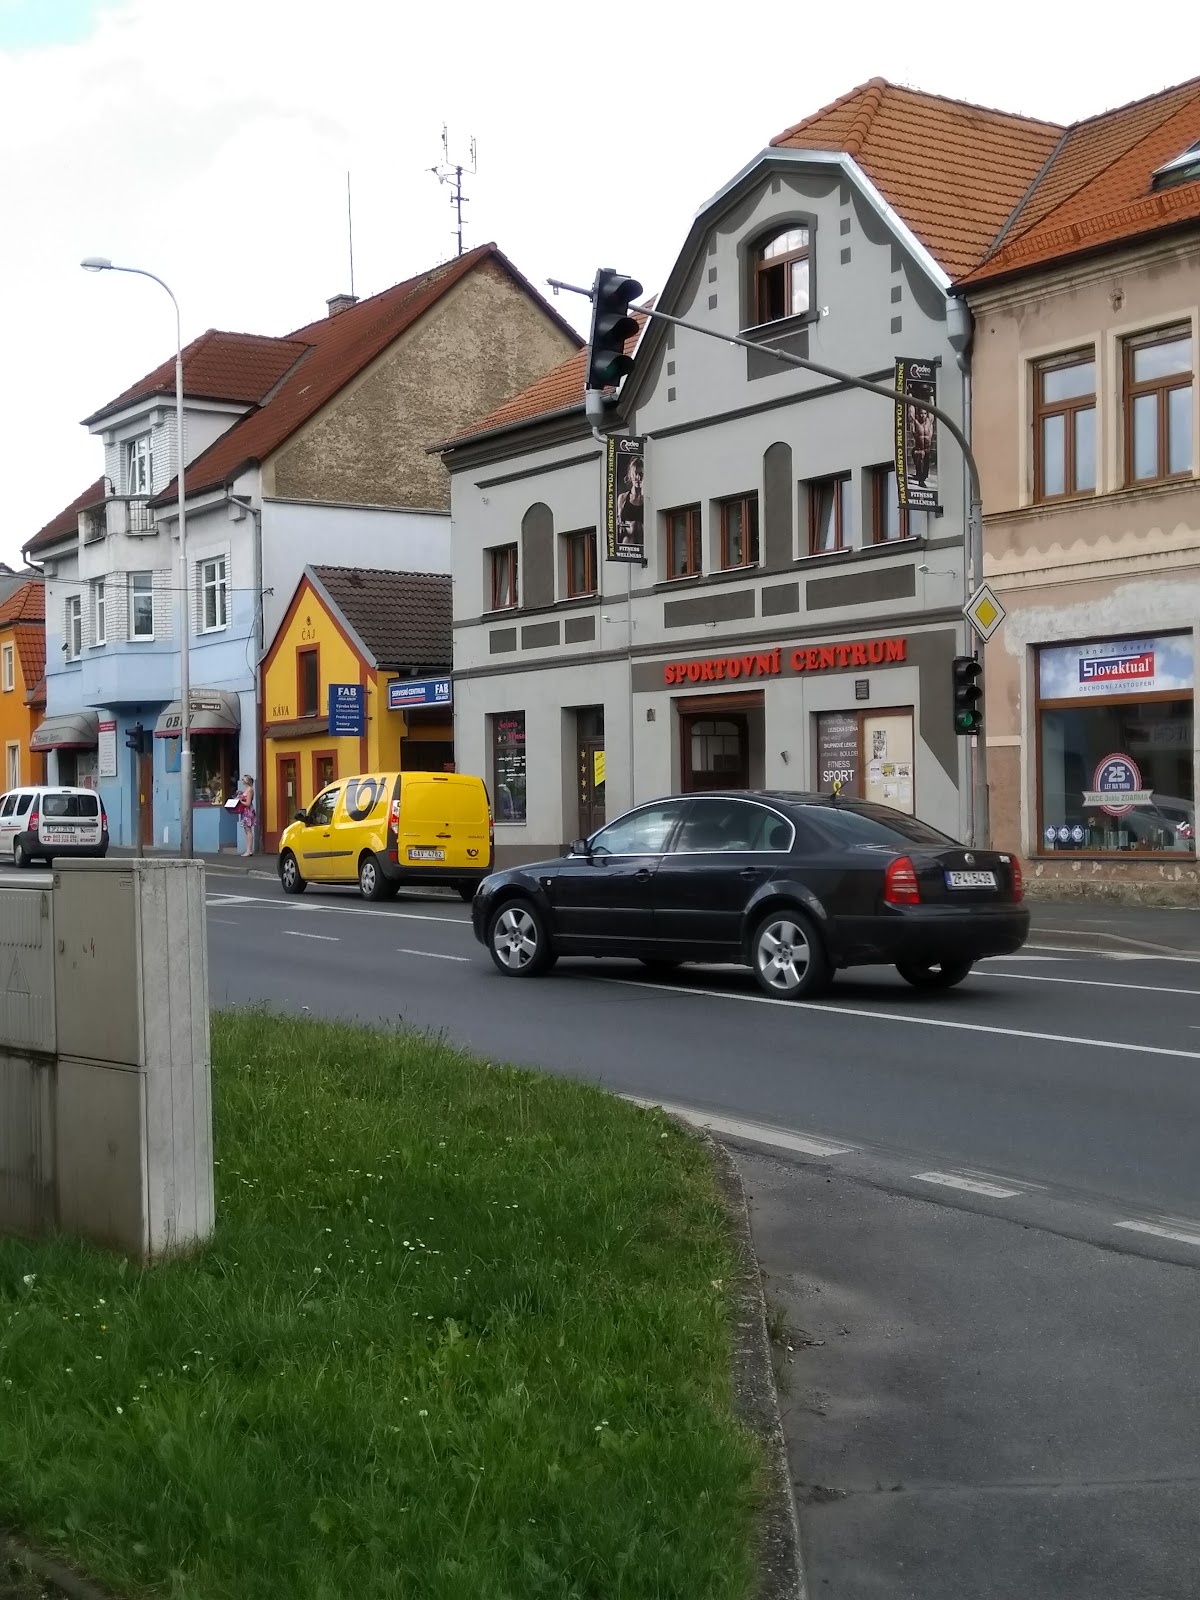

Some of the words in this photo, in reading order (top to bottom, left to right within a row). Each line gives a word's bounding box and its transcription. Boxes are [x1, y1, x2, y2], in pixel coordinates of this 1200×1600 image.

[910, 364, 931, 378] Rodeo
[896, 363, 904, 395] ÉNINK
[301, 628, 316, 640] ČAJ
[1079, 648, 1103, 656] okna
[1122, 643, 1154, 652] dveře
[664, 647, 781, 685] SPORTOVNÍ
[790, 638, 907, 671] CENTRUM
[1083, 656, 1149, 677] Slovaktual
[435, 683, 449, 694] FAB
[1114, 680, 1155, 688] ZASTOUPENÍ
[338, 687, 357, 696] FAB
[272, 704, 290, 716] KÁVA
[827, 760, 850, 768] FITNESS
[823, 770, 855, 782] SPORT
[1108, 766, 1126, 783] 25
[952, 872, 967, 885] 2P4
[972, 872, 991, 884] 5439
